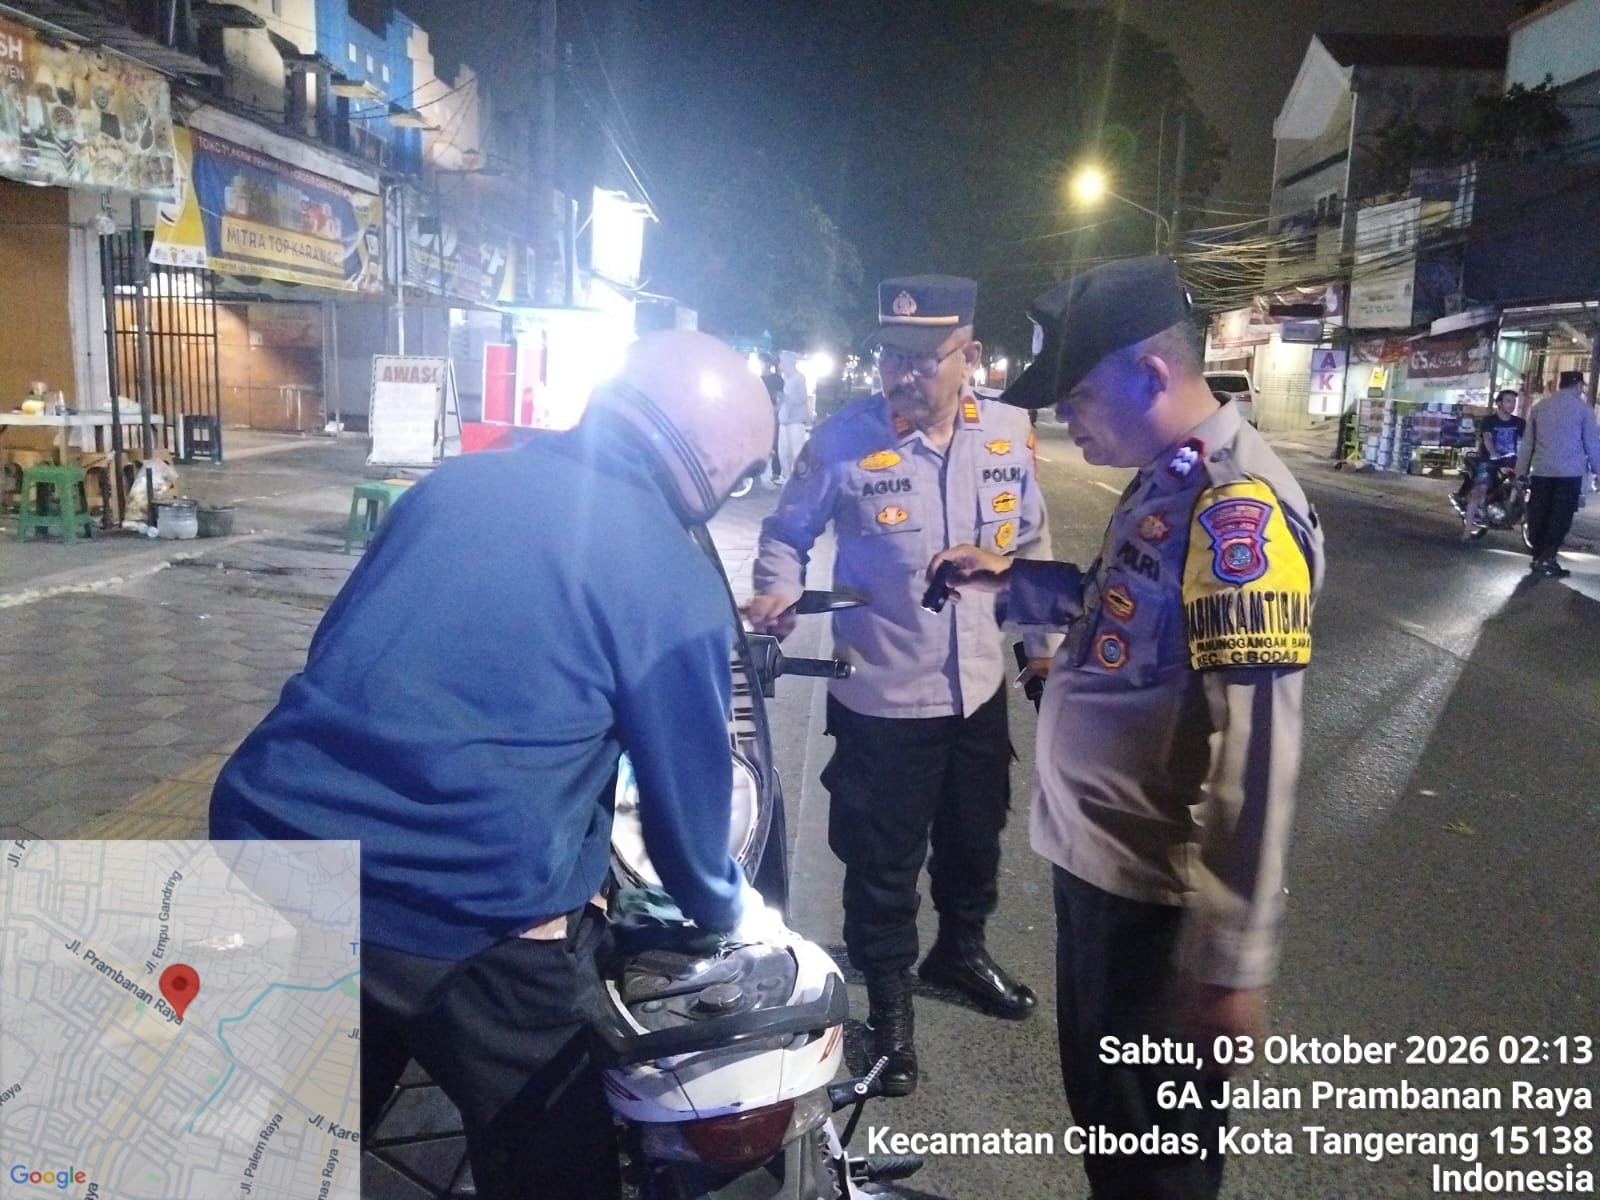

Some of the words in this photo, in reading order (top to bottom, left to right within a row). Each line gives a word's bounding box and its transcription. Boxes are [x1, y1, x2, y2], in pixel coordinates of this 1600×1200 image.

[227, 228, 266, 250] MITRA
[383, 366, 438, 383] AWAS!
[1318, 352, 1337, 412] AKI
[982, 467, 1021, 483] POLRI
[862, 477, 912, 497] AGUS
